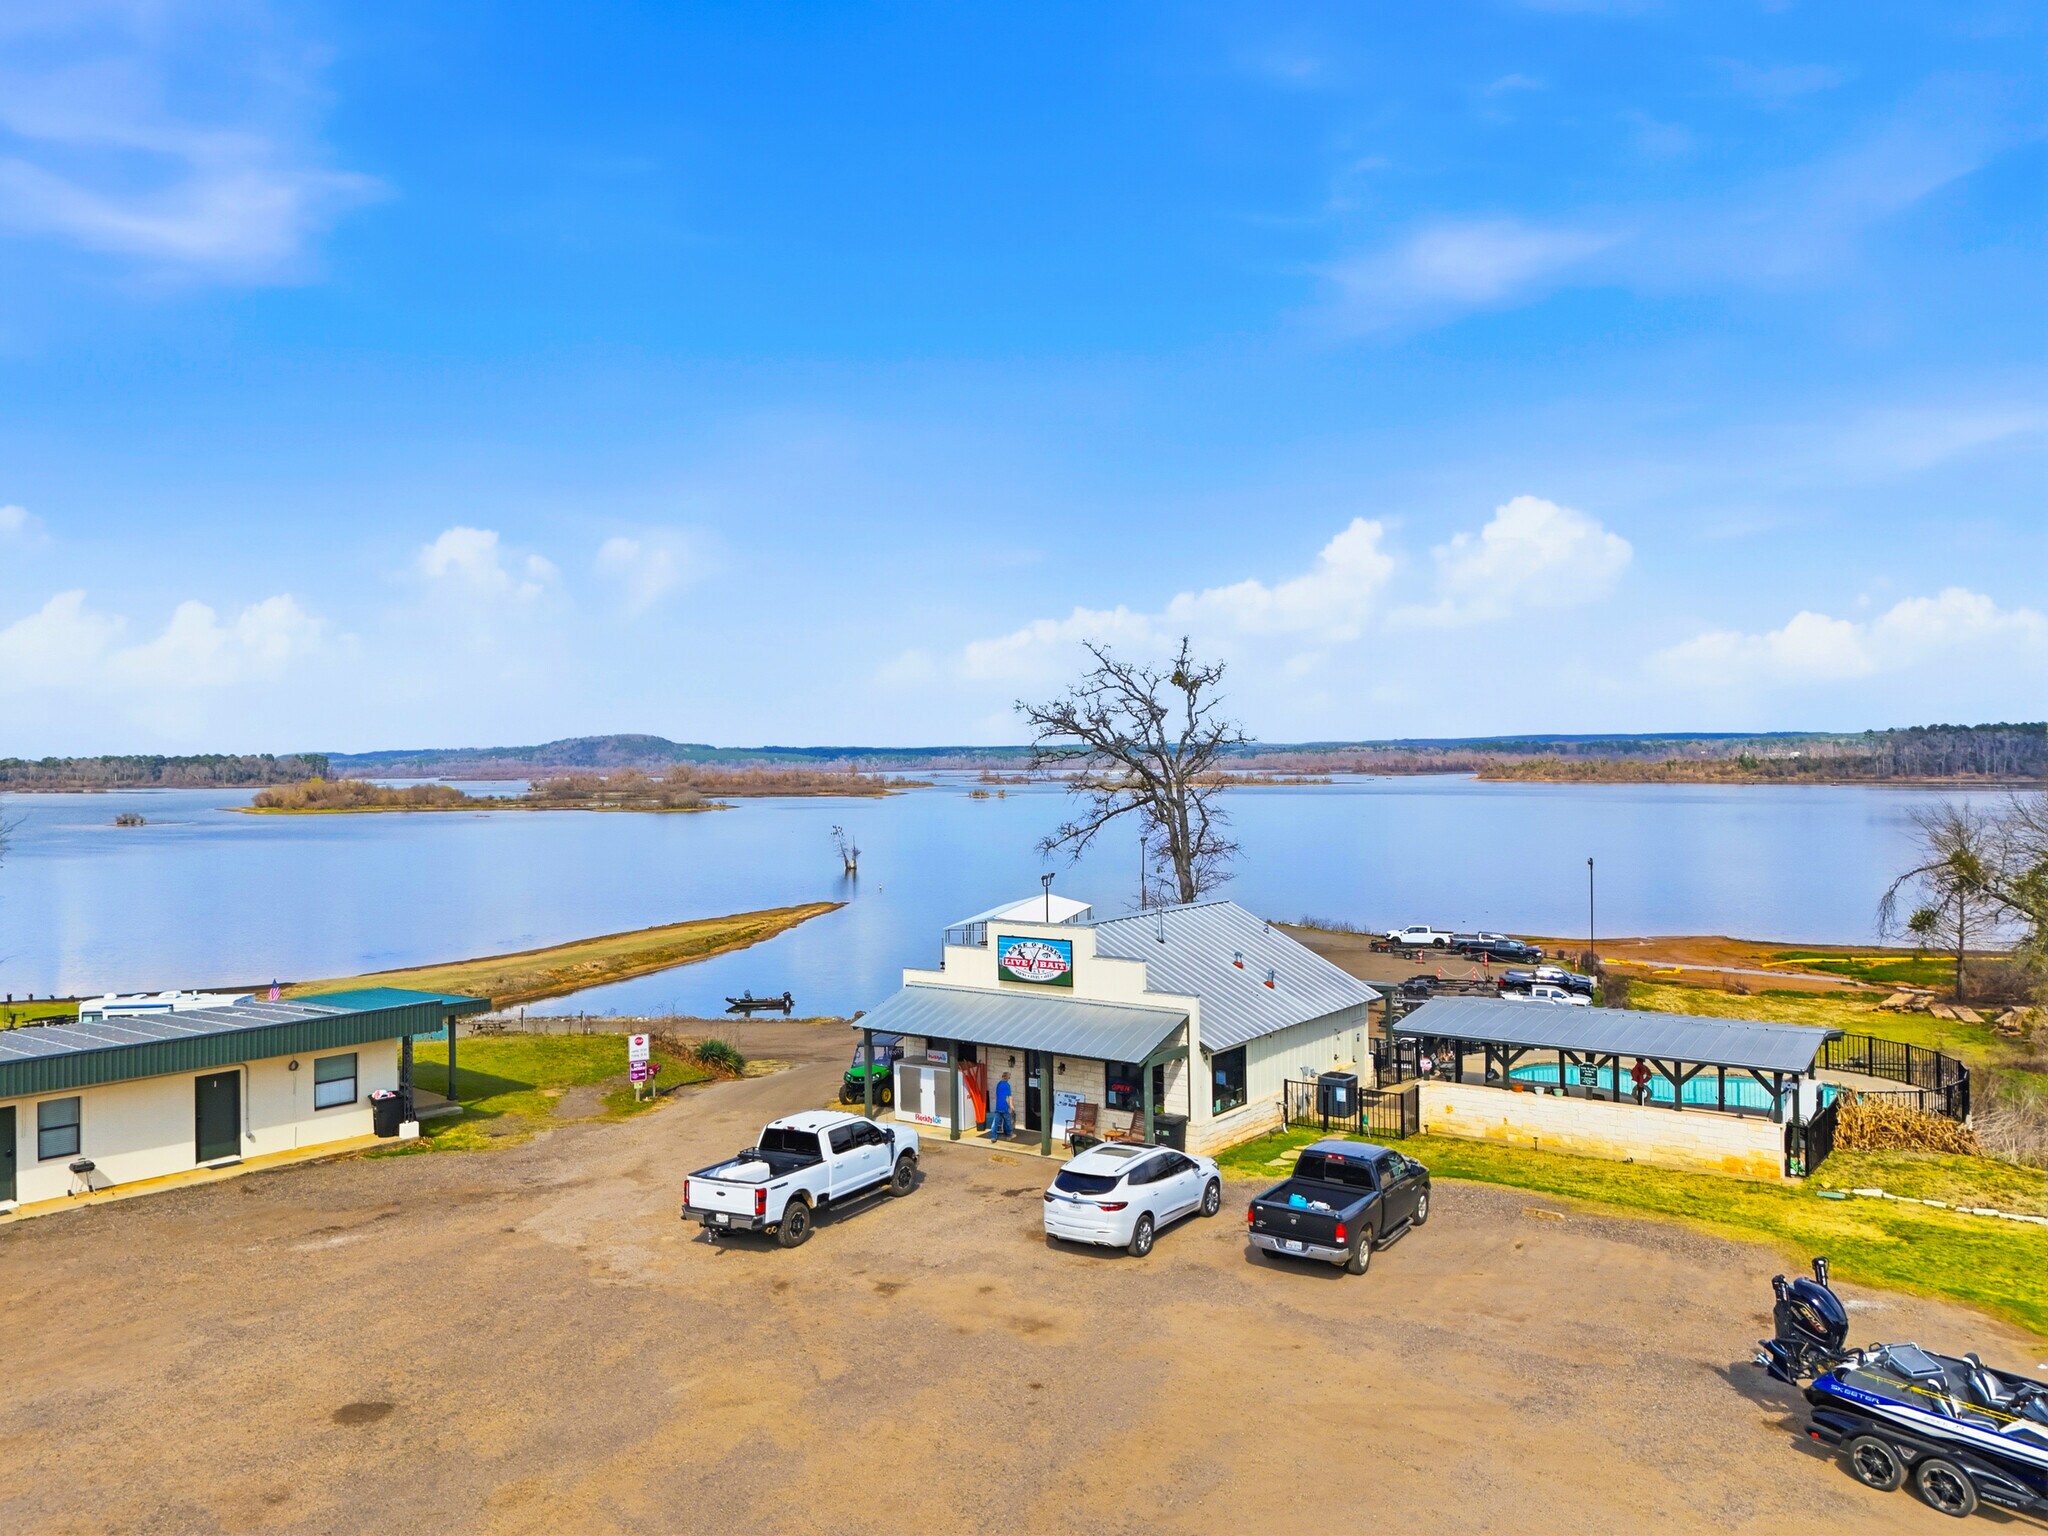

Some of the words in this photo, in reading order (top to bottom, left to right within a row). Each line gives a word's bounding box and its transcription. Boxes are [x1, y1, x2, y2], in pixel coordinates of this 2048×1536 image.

[1008, 943, 1028, 955] LAKE
[1042, 944, 1062, 959] PINES
[1005, 958, 1028, 966] LIVE
[1040, 961, 1066, 970] BAIT
[1111, 1083, 1131, 1092] OPEN
[1830, 1383, 1880, 1405] SKEETER
